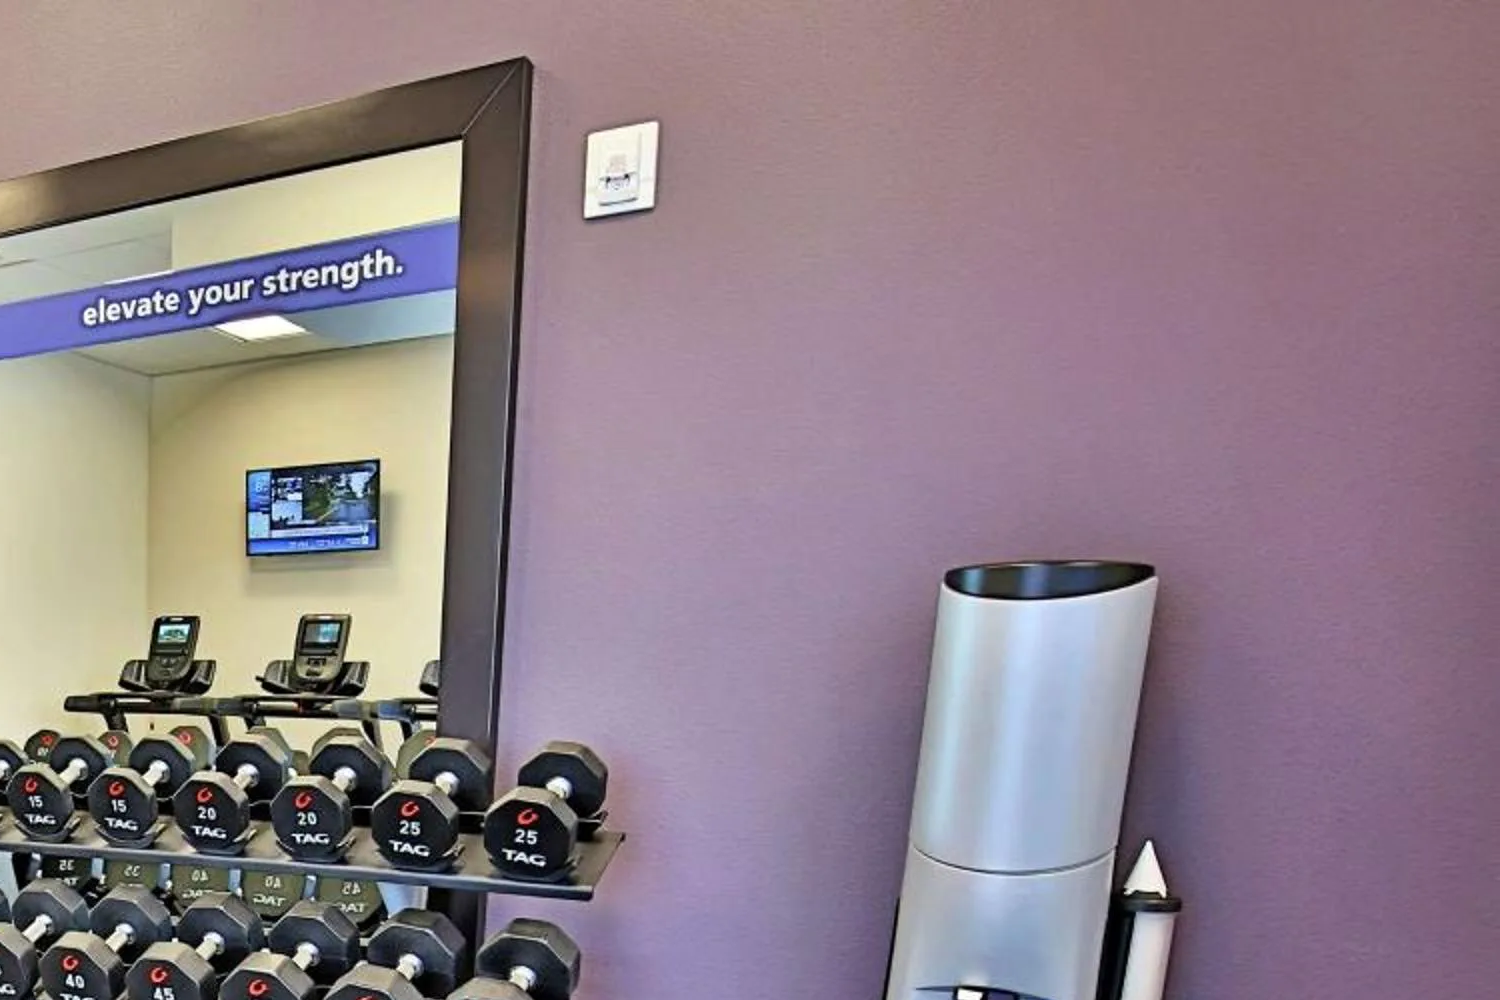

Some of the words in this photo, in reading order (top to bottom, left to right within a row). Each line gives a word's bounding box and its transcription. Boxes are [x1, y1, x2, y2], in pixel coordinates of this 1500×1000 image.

[82, 291, 180, 326] elevate
[188, 278, 255, 315] your
[262, 249, 404, 290] strength.
[28, 796, 43, 808] 15
[111, 799, 127, 813] 15
[24, 813, 56, 825] TAG
[197, 806, 217, 820] 20
[297, 812, 317, 825] 20
[105, 817, 139, 831] TAG
[400, 820, 421, 836] 25
[191, 825, 227, 839] TAG
[291, 833, 330, 844] TAG
[514, 829, 538, 844] 25
[389, 839, 430, 857] TAG
[502, 849, 547, 867] TAG
[65, 974, 84, 989] 40
